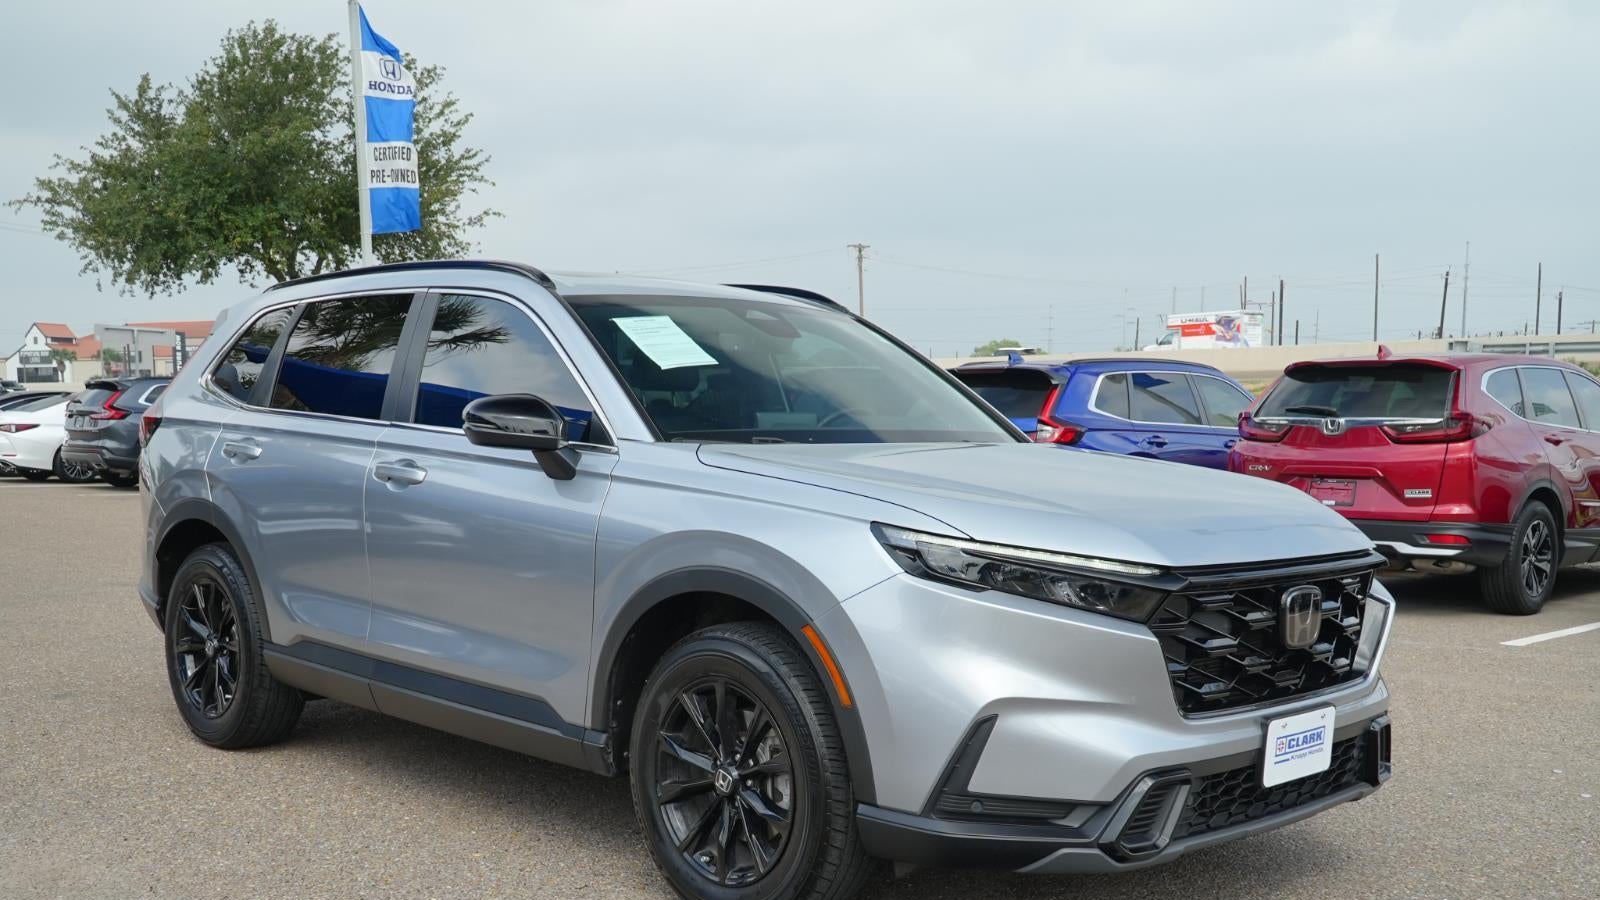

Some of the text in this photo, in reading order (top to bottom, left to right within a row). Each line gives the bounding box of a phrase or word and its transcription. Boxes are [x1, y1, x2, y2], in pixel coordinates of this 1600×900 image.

[368, 80, 413, 95] HONDA
[373, 146, 412, 162] CERTIFIED
[370, 168, 417, 184] PRE-OWNED
[1287, 730, 1323, 750] CLARK
